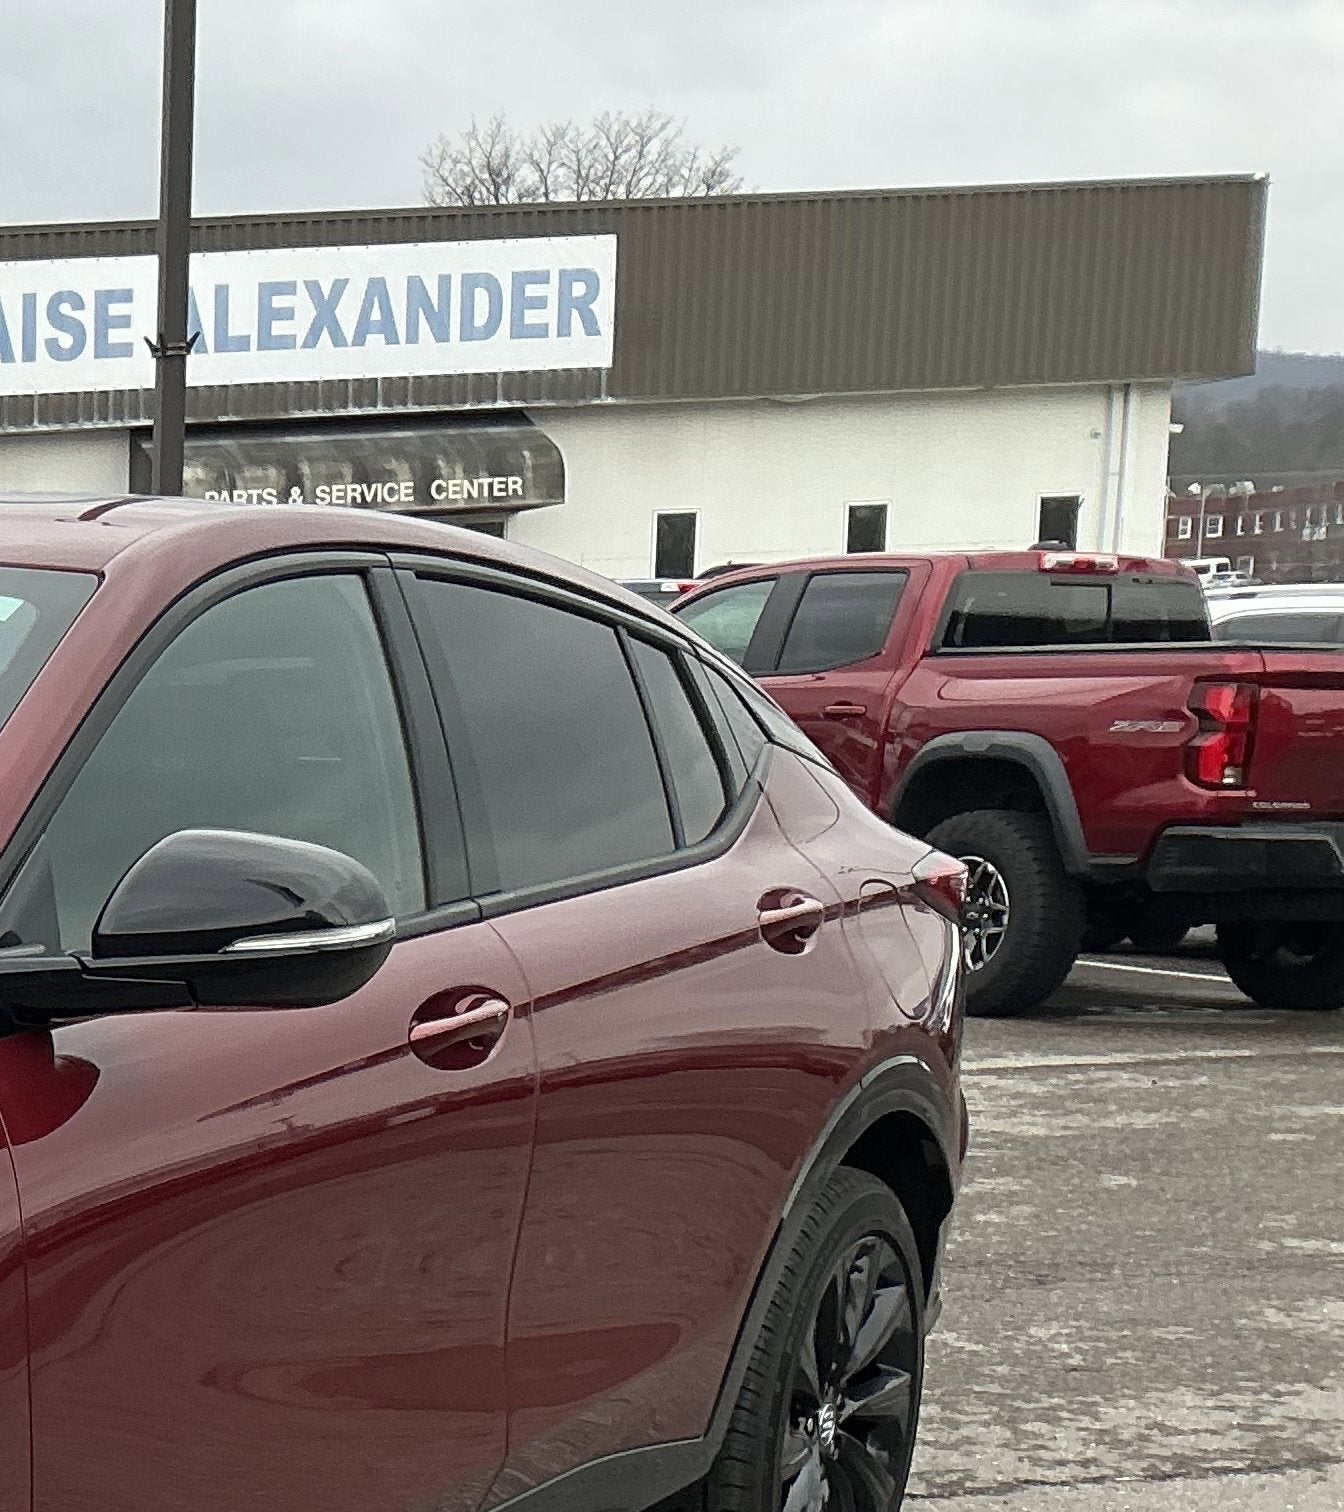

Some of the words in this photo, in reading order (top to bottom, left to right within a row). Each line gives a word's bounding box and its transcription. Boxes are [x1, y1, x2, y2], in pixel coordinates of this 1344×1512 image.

[288, 486, 304, 505] &
[315, 481, 415, 506] SERVICE
[430, 476, 524, 501] CENTER
